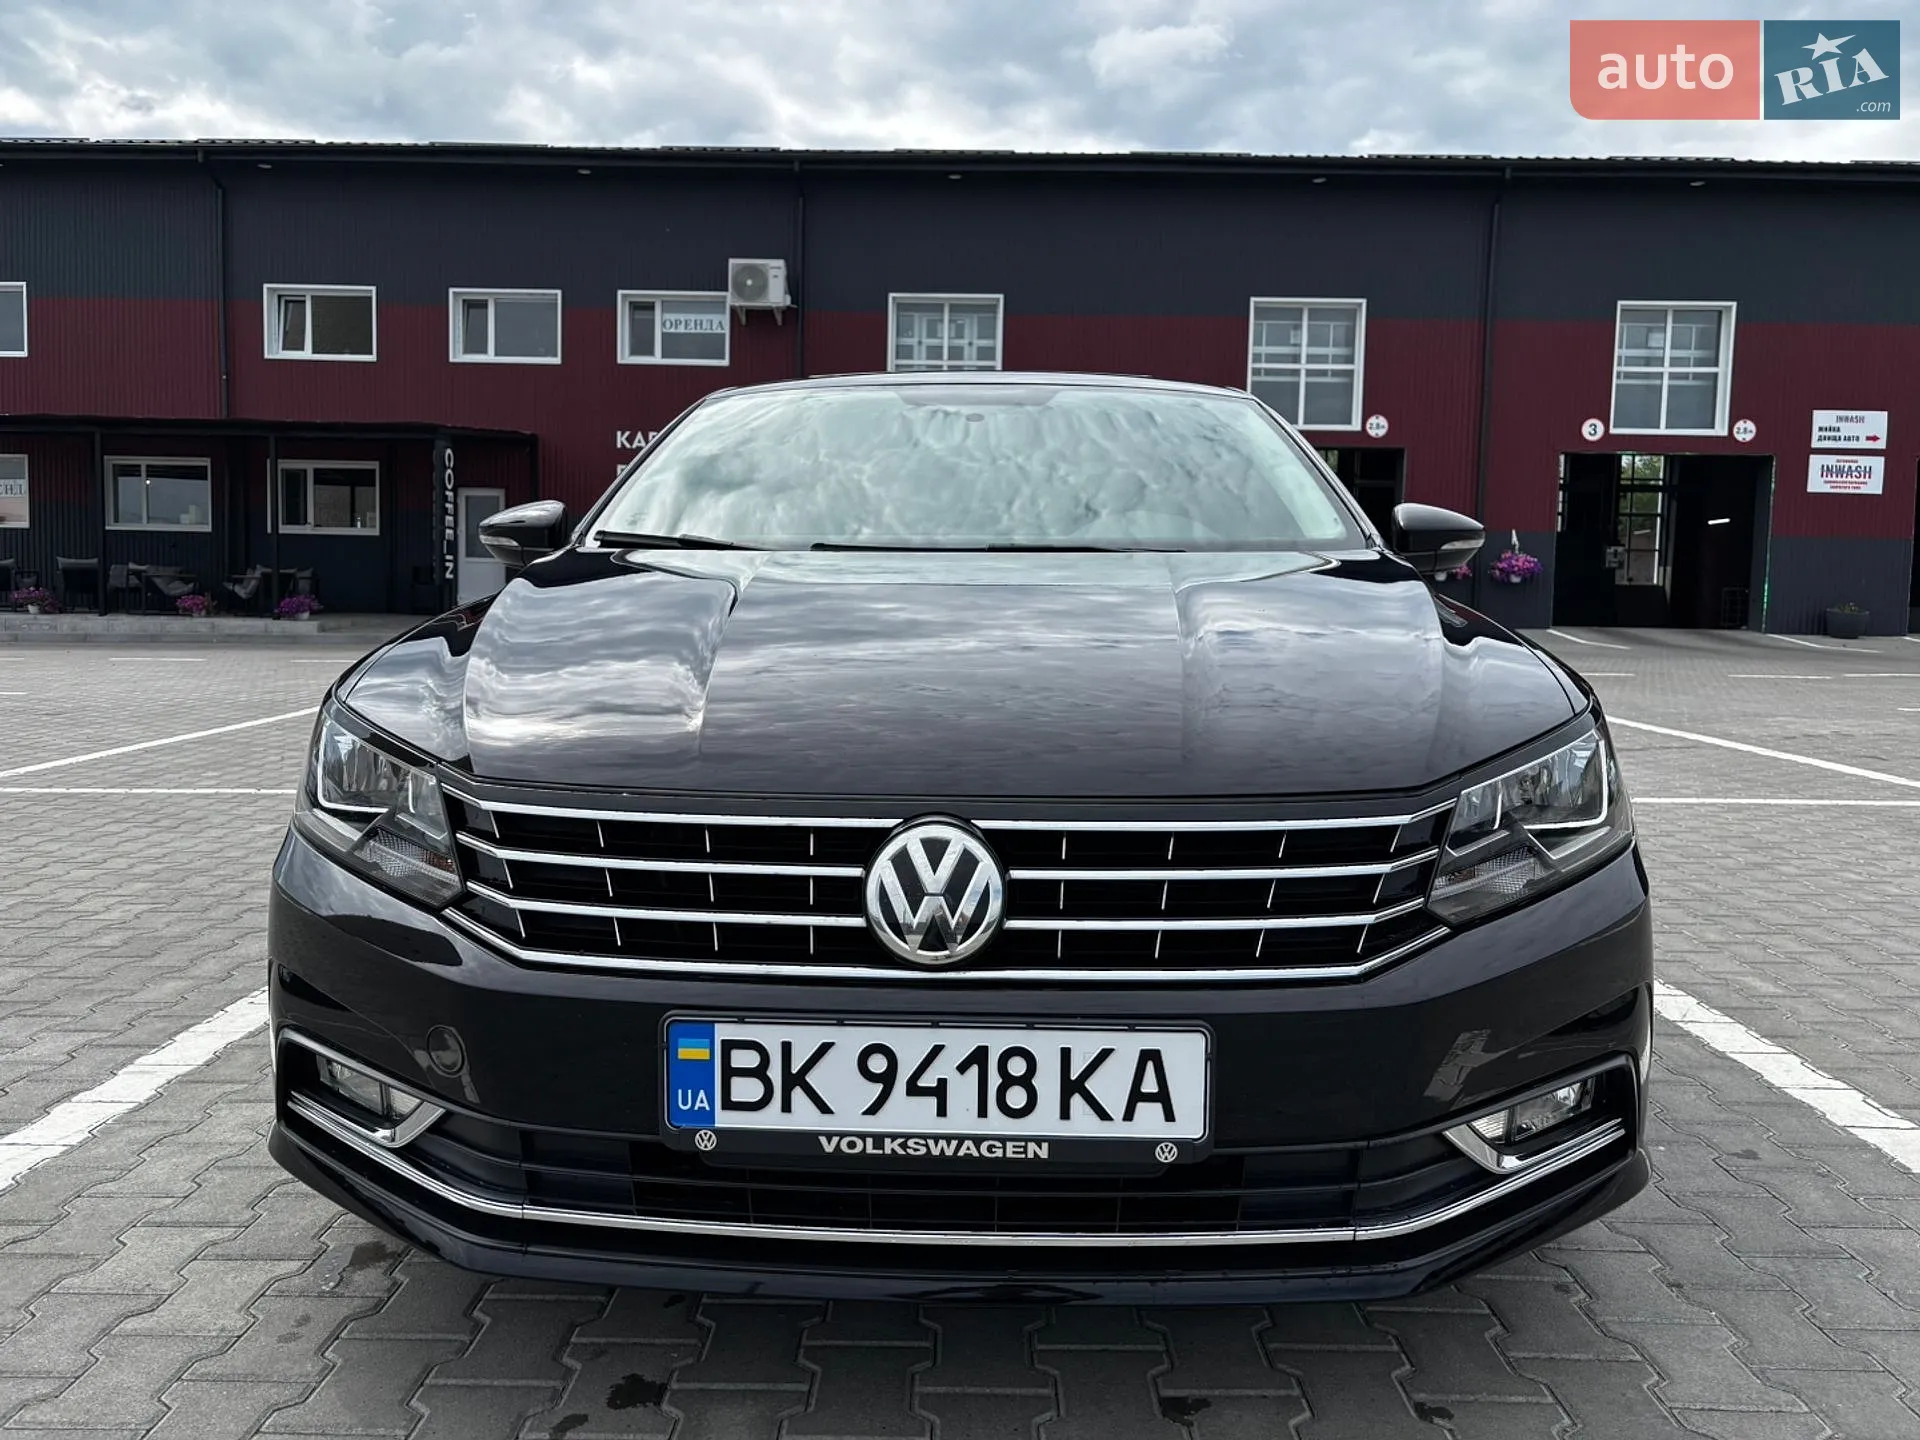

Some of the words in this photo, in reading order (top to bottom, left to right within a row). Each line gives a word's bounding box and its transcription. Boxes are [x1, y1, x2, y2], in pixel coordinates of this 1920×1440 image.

[662, 318, 726, 331] ОРЕНДА
[1836, 415, 1865, 424] INWASH
[1588, 423, 1597, 436] 3
[1843, 435, 1860, 443] АВТО
[1820, 463, 1873, 480] INWASH
[720, 1038, 836, 1115] BK
[856, 1042, 1039, 1120] 9418
[1059, 1046, 1176, 1123] KA
[677, 1088, 711, 1111] UA
[818, 1135, 1051, 1159] VOLKSWAGEN
